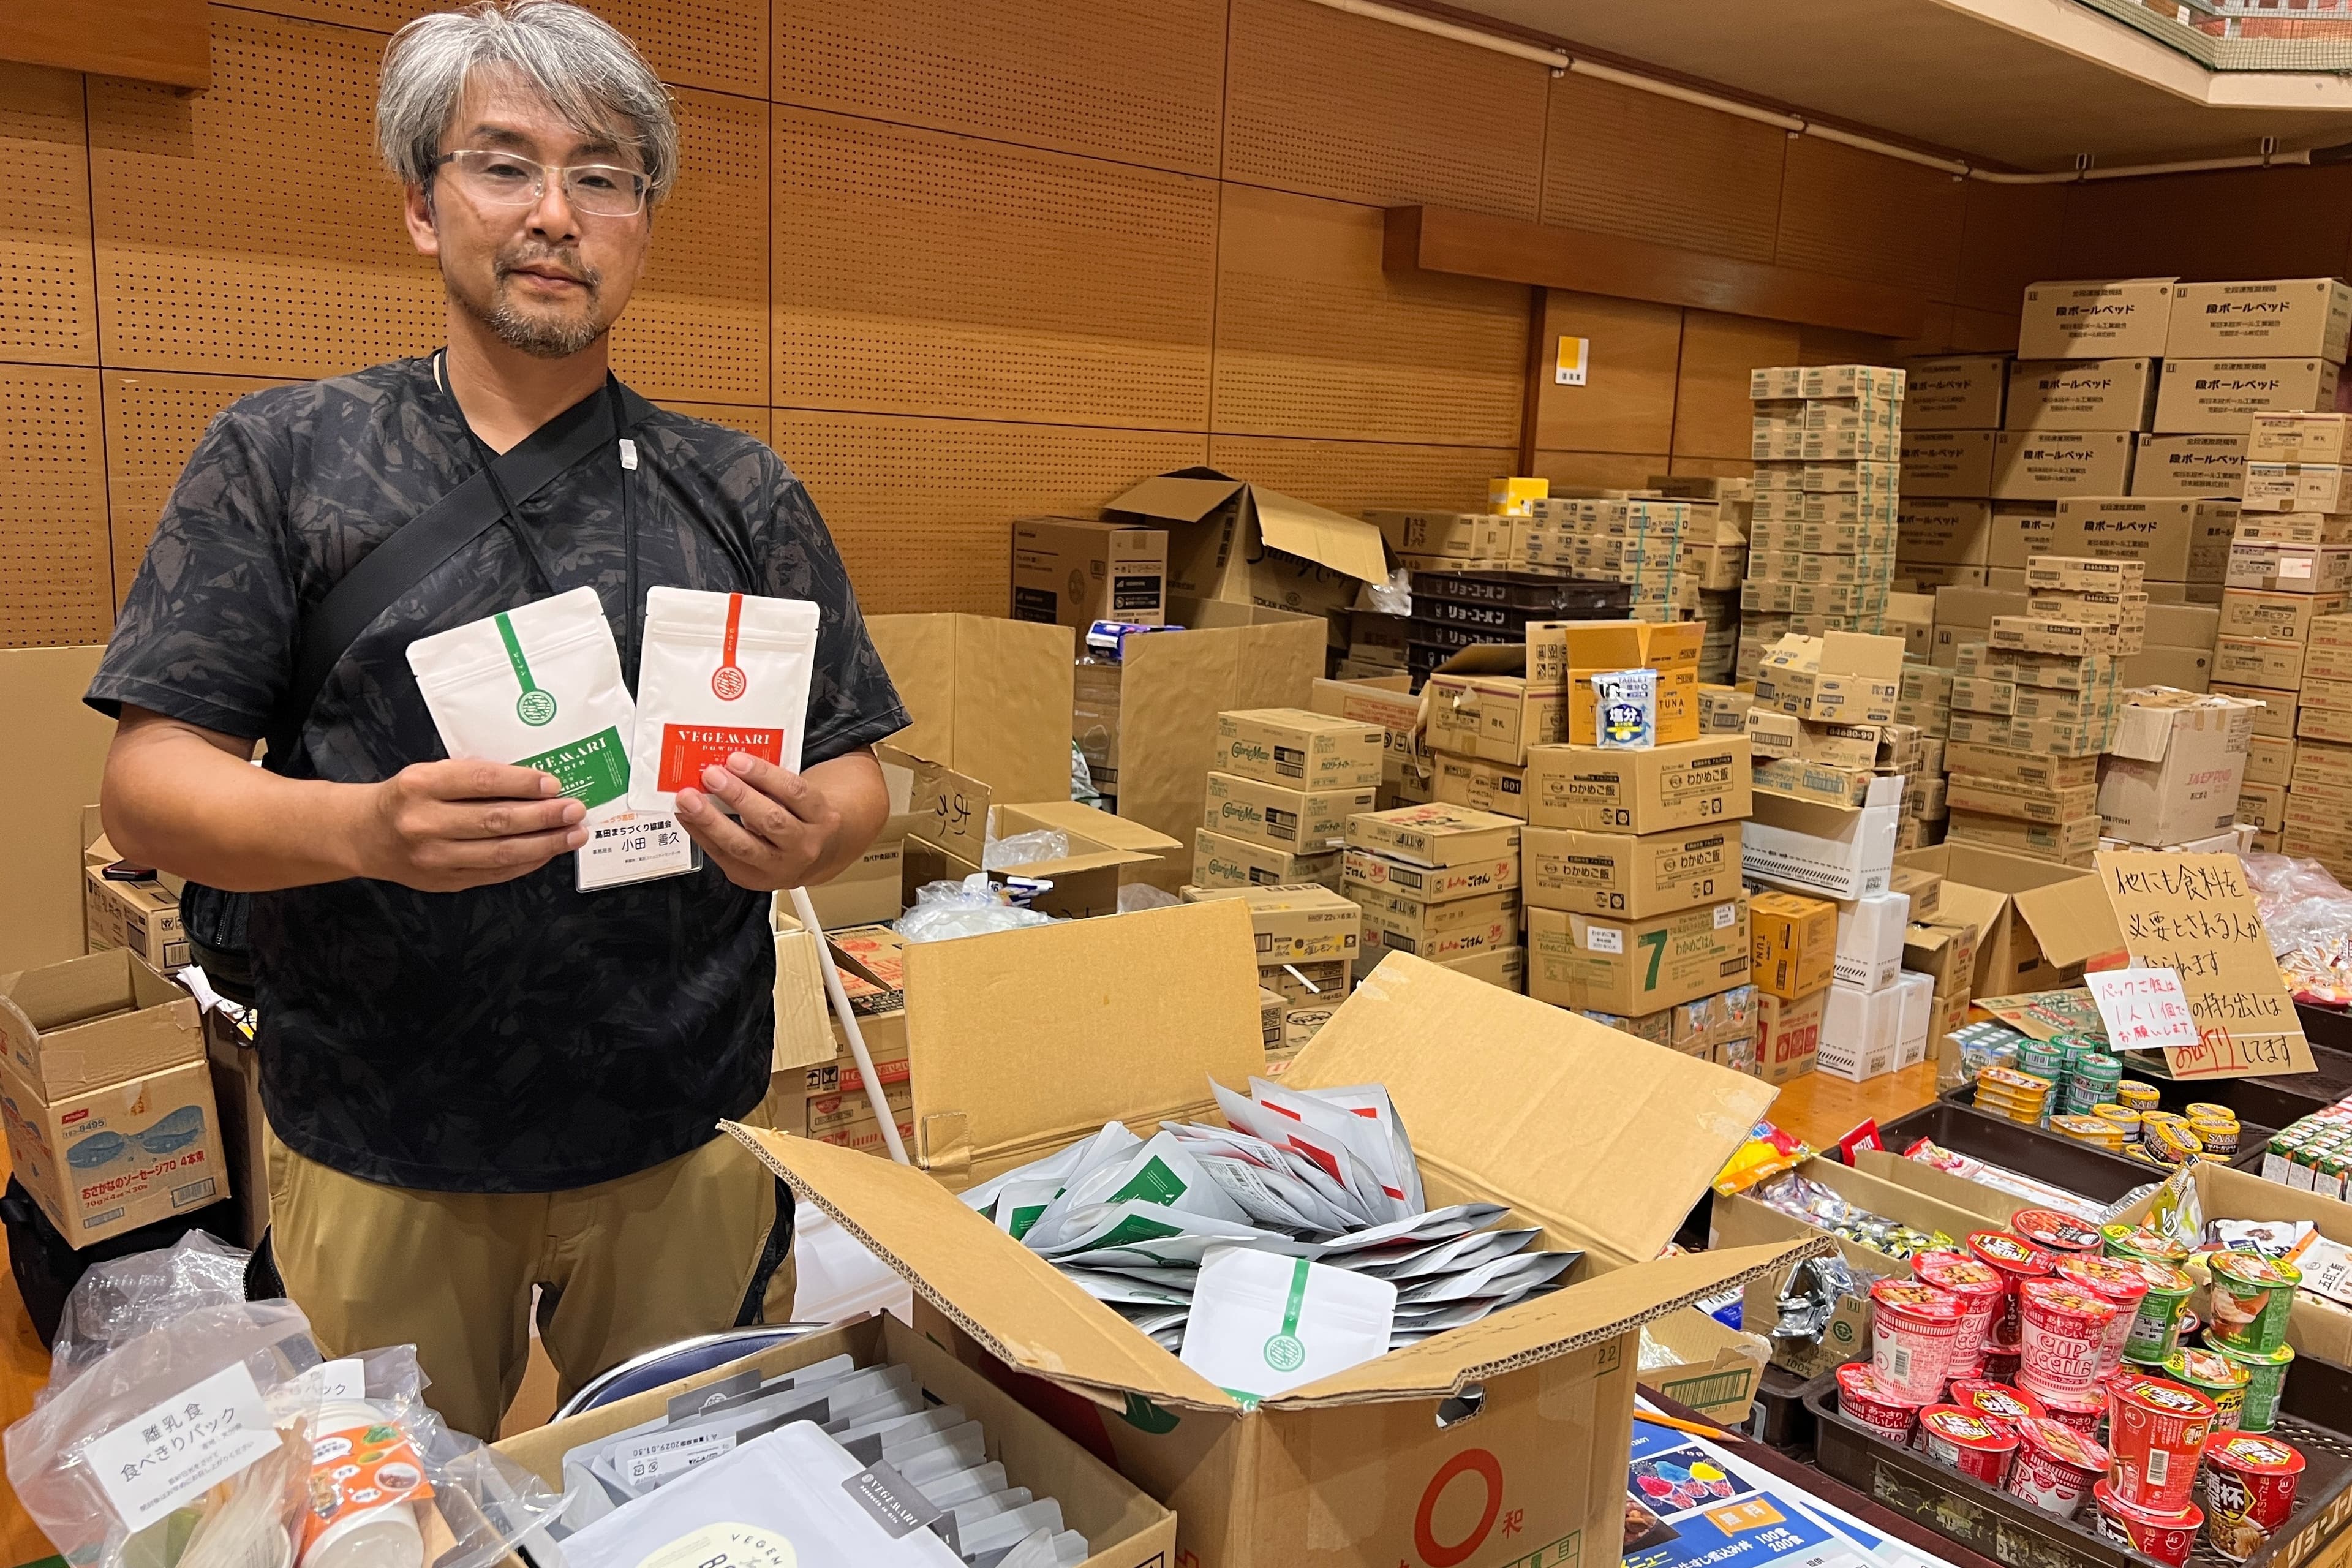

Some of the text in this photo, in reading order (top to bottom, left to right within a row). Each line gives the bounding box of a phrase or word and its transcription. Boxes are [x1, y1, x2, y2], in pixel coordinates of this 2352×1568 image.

[2056, 305, 2135, 317] 段ボールベッド
[2206, 302, 2290, 314] 段ボールベッド
[2038, 379, 2111, 390] 段ボールベッド
[2196, 380, 2279, 390] 段ボールベッド
[2023, 450, 2094, 460] 段ボールベッド
[2084, 521, 2157, 532] 段ボールベッド
[1449, 605, 1505, 625] リョーユーパン
[1659, 698, 1684, 710] TUNA
[1609, 707, 1638, 722] 塩分
[678, 729, 770, 745] VEGEMARI
[525, 737, 607, 772] GEMARI
[1503, 778, 1520, 792] 601
[1687, 767, 1728, 786] わかめご飯
[1569, 783, 1615, 796] わかめご飯
[622, 837, 646, 853] 小田
[658, 831, 680, 846] 善久
[1681, 849, 1721, 869] わかめご飯
[1345, 865, 1366, 880] ごはん
[1563, 865, 1610, 880] わかめご飯
[2116, 864, 2244, 900] 他にも食料を
[2128, 910, 2262, 943] 必要とされる人が
[1676, 934, 1716, 956] わかめごはん
[1753, 933, 1767, 969] TUNA
[1638, 929, 1668, 992] 7
[2101, 978, 2176, 1000] パックご飯は
[2131, 1098, 2158, 1109] SABA
[2207, 1133, 2237, 1144] SABA
[81, 1162, 176, 1200] おさかなのソーセージ70
[2044, 1322, 2082, 1340] おいしい
[2046, 1315, 2082, 1330] あっさり
[2037, 1333, 2087, 1359] CUP
[1598, 1345, 1616, 1366] 22
[1785, 1357, 1813, 1378] 100%
[1865, 1414, 1902, 1428] おいしい
[1868, 1406, 1903, 1420] あっさり
[2057, 1414, 2092, 1425] あっさり
[141, 1401, 204, 1446] 離乳食
[120, 1406, 237, 1483] 食べきりパック
[871, 1479, 918, 1527] VEGEMARI
[1718, 1502, 1767, 1526] 無料
[1501, 1509, 1524, 1540] 和
[1753, 1528, 1792, 1545] 100食
[1767, 1534, 1806, 1555] 200食
